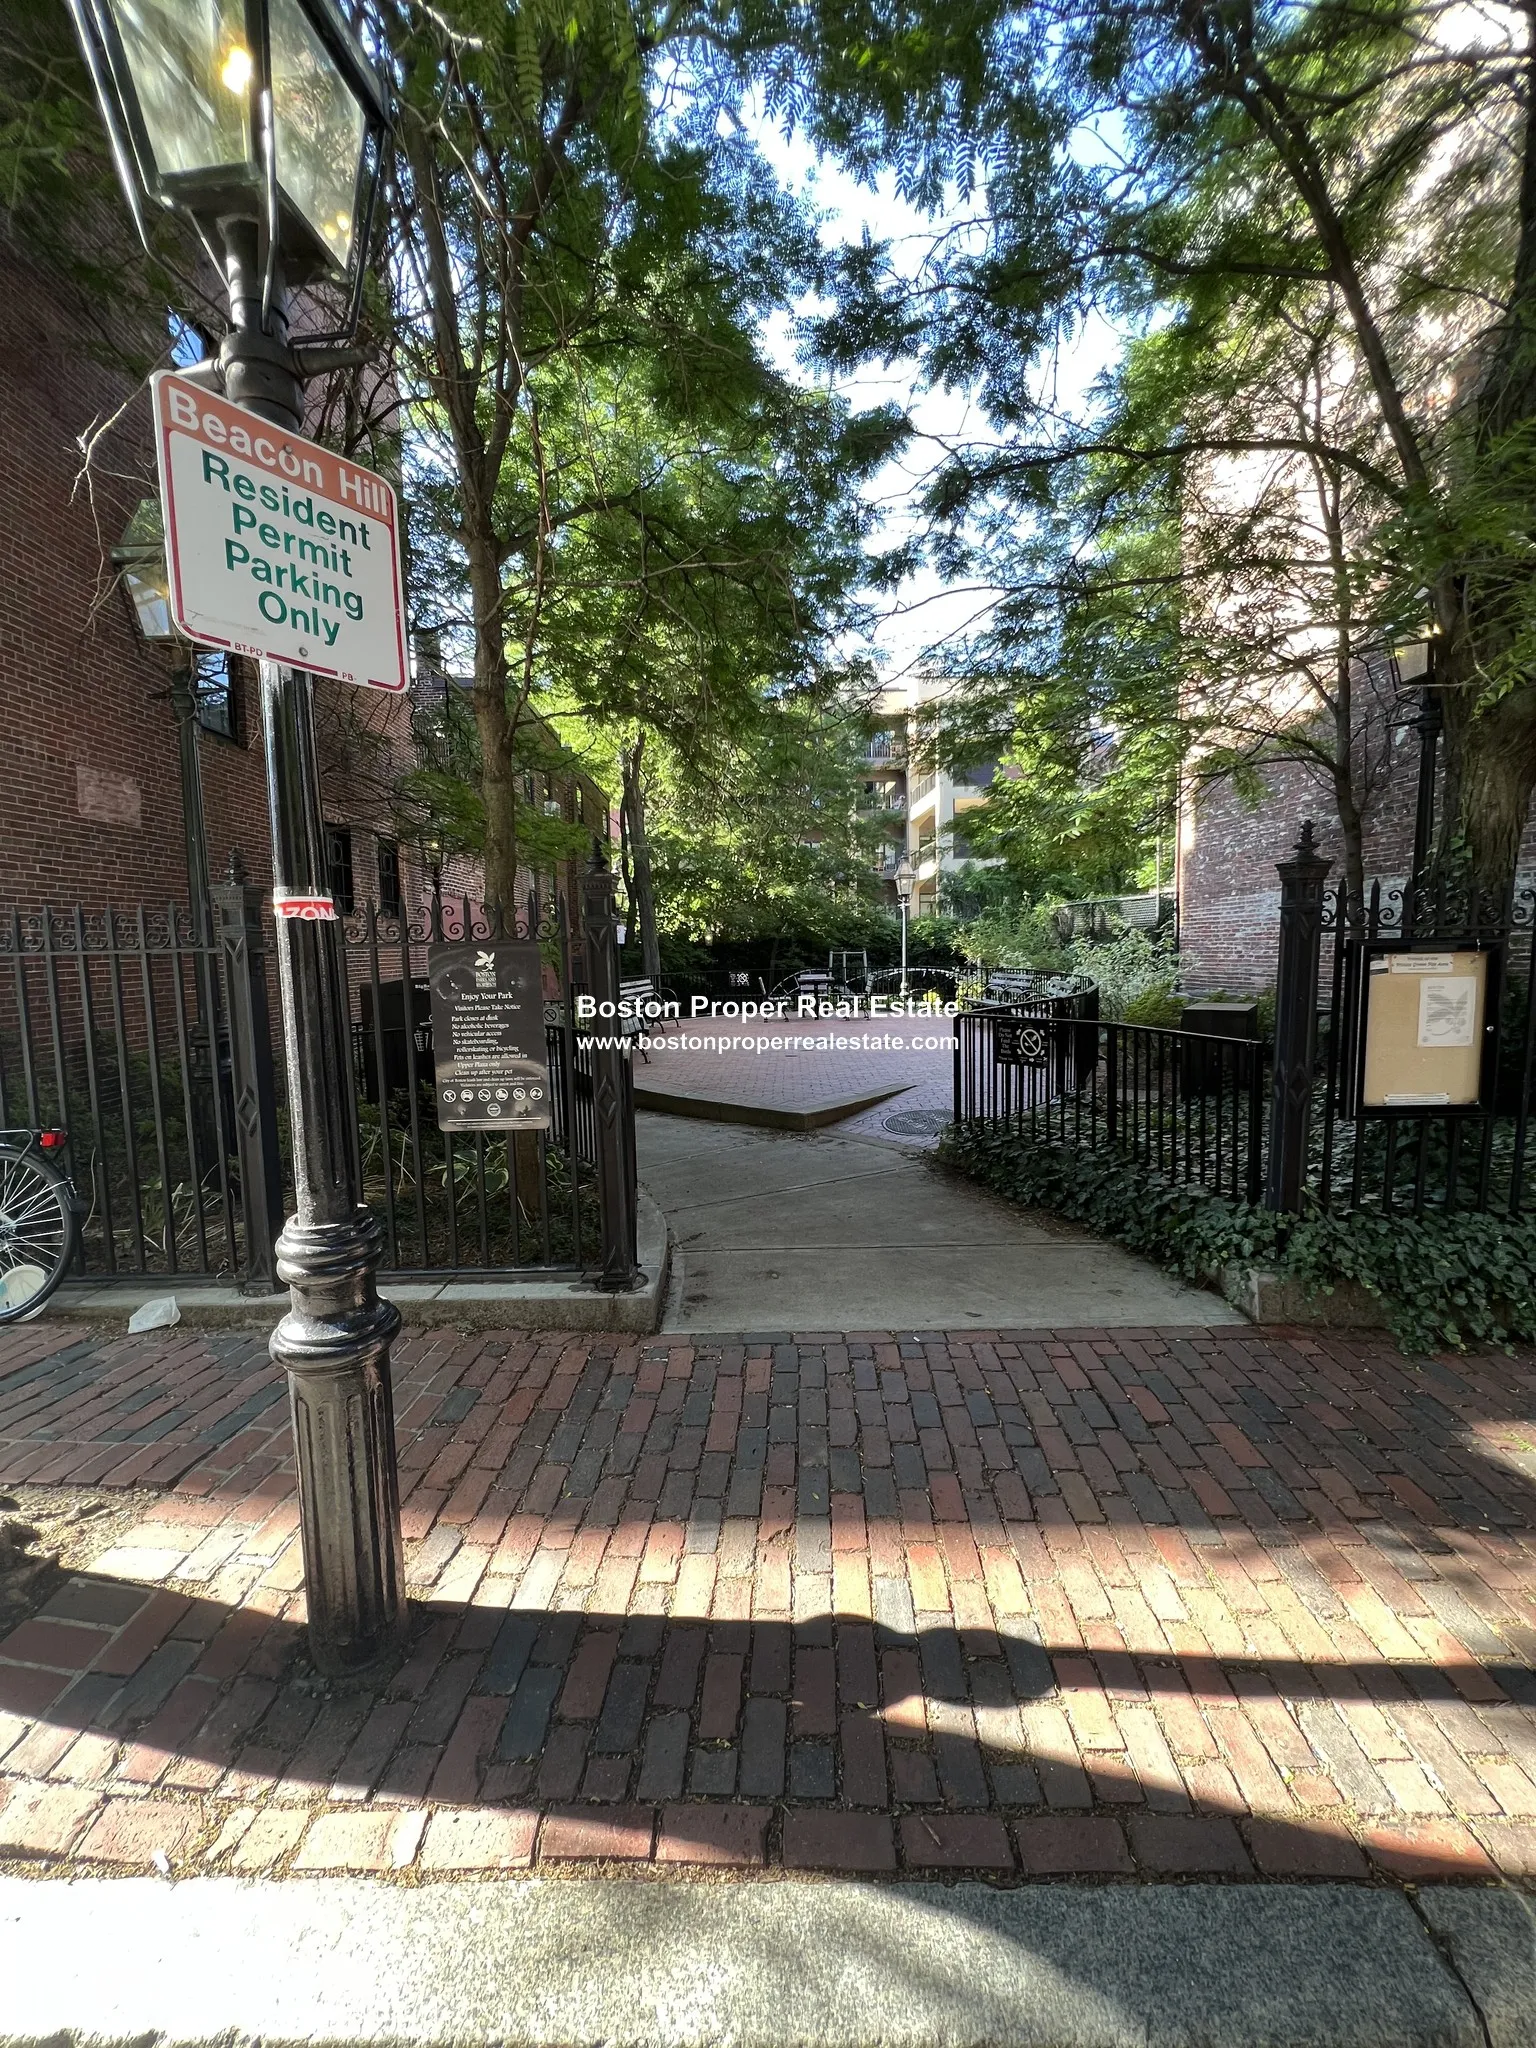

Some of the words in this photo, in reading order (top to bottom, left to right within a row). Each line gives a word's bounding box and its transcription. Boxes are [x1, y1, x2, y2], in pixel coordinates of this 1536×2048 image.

[167, 384, 324, 489] Beacon
[339, 467, 389, 516] Hill
[201, 448, 371, 552] Resident
[232, 501, 353, 578] Permit
[224, 538, 364, 621] Parking
[257, 590, 341, 647] Only
[234, 641, 264, 657] BT-PD
[461, 993, 480, 1002] Enjoy
[480, 992, 497, 1000] Your
[497, 991, 514, 1000] Park
[485, 1013, 499, 1021] dusk
[484, 1022, 510, 1030] beverages
[453, 1053, 465, 1061] Pets
[457, 1061, 475, 1069] Upper
[488, 1060, 501, 1068] only
